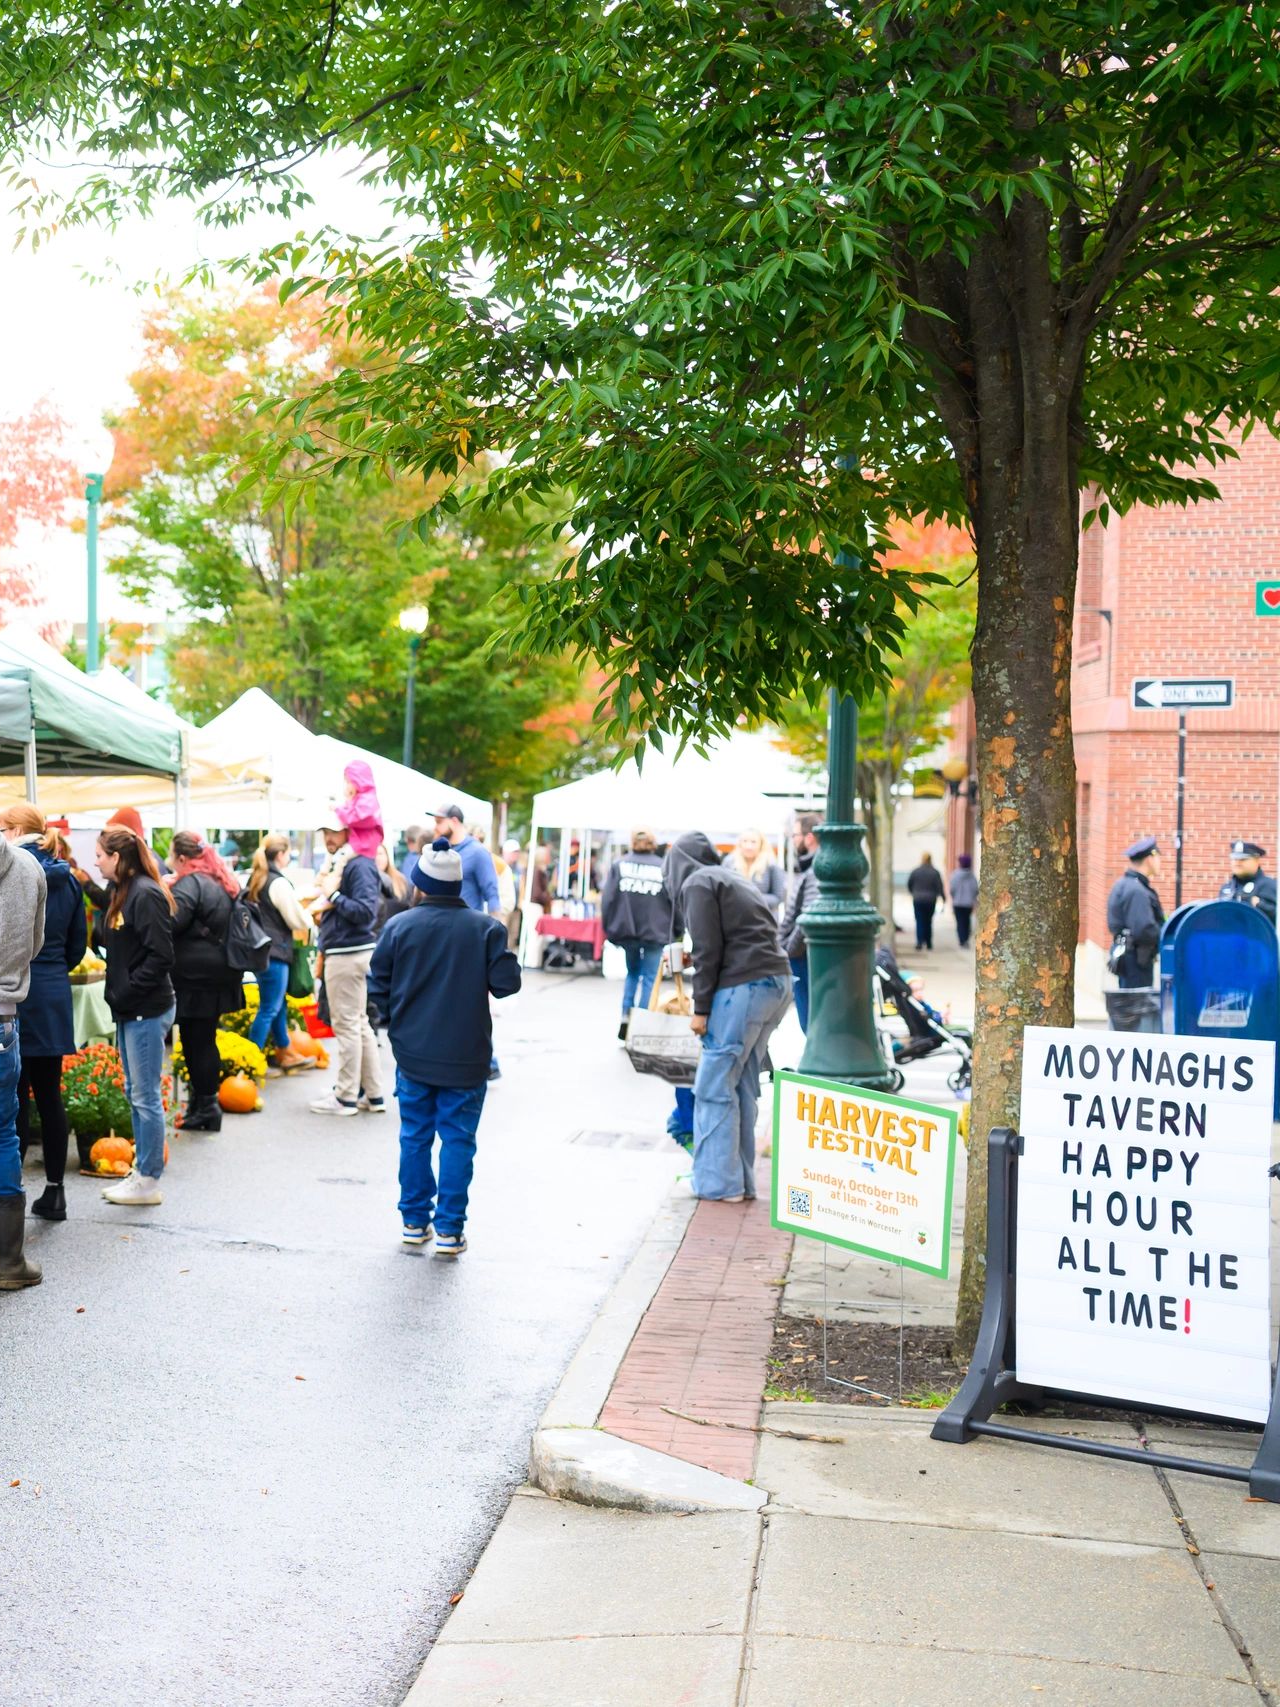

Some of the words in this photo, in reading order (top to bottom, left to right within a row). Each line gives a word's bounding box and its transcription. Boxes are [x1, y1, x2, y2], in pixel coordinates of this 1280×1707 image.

[1043, 1043, 1254, 1092] MOYNAGHS
[796, 1090, 938, 1153] HARVEST
[1063, 1093, 1206, 1139] TAVERN
[807, 1125, 918, 1176] FESTIVAL
[1062, 1140, 1200, 1186] HAPPY
[830, 1190, 841, 1201] at
[843, 1191, 867, 1208] 11am
[875, 1200, 900, 1217] 2pm
[848, 1179, 894, 1201] October
[896, 1191, 919, 1208] 13th
[1071, 1188, 1193, 1236] HOUR
[817, 1204, 850, 1221] Exchange
[851, 1214, 858, 1223] St
[868, 1219, 902, 1235] Worcester
[1057, 1235, 1126, 1276] ALL
[1082, 1286, 1191, 1334] TIME!
